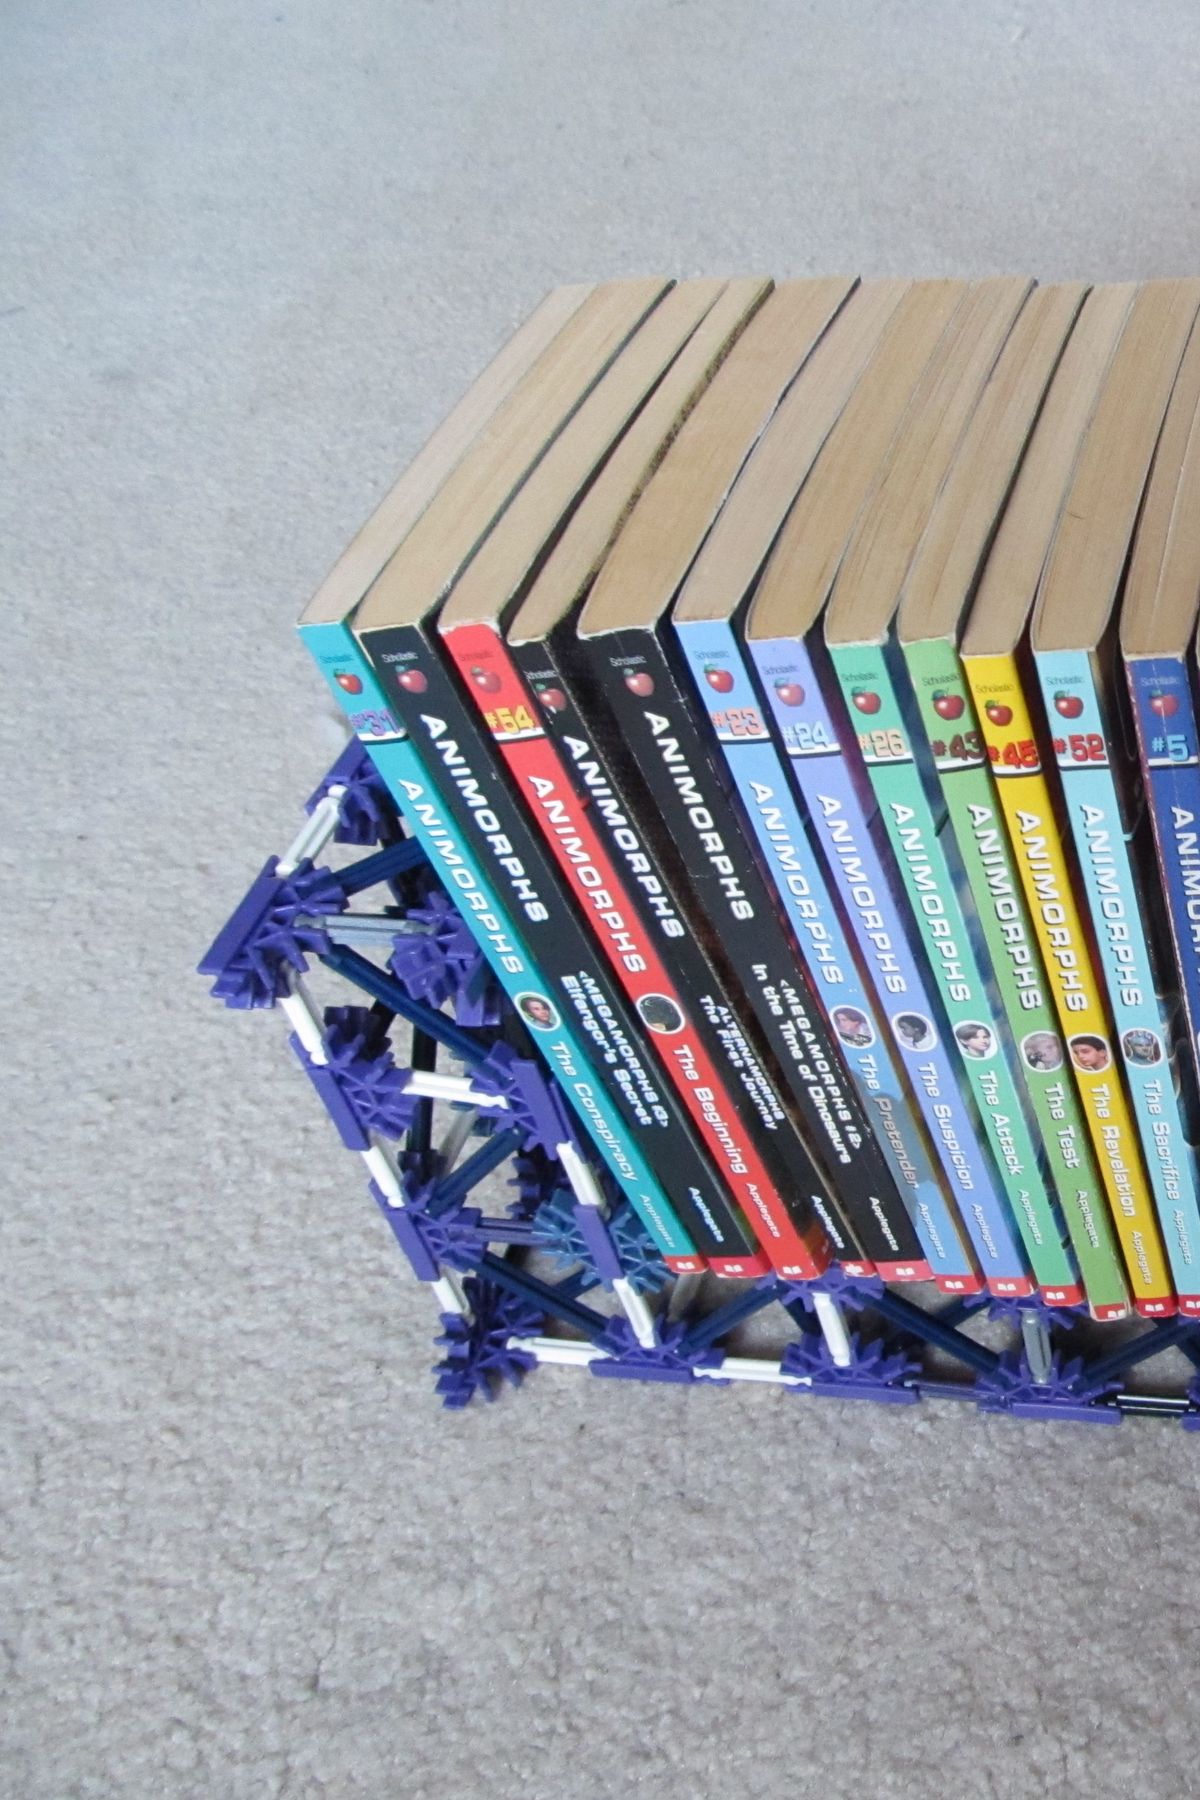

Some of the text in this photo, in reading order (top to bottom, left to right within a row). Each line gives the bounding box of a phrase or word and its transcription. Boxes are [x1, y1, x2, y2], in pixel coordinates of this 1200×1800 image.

[351, 709, 399, 736] #31
[485, 704, 535, 734] #54
[712, 708, 761, 736] #23
[841, 672, 879, 683] Scholastic
[923, 673, 961, 686] Scholastic
[976, 683, 1015, 694] Scholastic
[1046, 675, 1085, 686] Scholastic
[782, 722, 828, 750] #24
[859, 729, 905, 757] #26
[931, 731, 985, 761] #43
[1051, 733, 1105, 761] #52
[1152, 735, 1189, 761] #5
[420, 713, 549, 922] ANIMORPHS
[563, 735, 685, 938] ANIMORPHS
[644, 711, 754, 920] ANIMORPHS
[399, 778, 524, 974] ANIMORPHS
[528, 775, 647, 973] ANIMORPHS
[749, 781, 844, 984] ANIMORPHS
[816, 794, 907, 993] ANIMORPHS
[890, 802, 971, 1002] ANIMORPHS
[967, 803, 1042, 1010] ANIMORPHS
[1015, 809, 1089, 1012] ANIMORPHS
[1080, 804, 1143, 1007] ANIMORPHS
[561, 975, 653, 1126] Elfangor's Secret
[700, 994, 778, 1130] The First Journey
[716, 1005, 786, 1121] ALTERNAMORPHS
[751, 963, 851, 1164] In the Time of Dinosaurs
[551, 1040, 638, 1181] The Conspiracy
[673, 1044, 748, 1174] The Beginning
[857, 1054, 919, 1190] The Pretender
[917, 1062, 974, 1191] The Suspicion
[978, 1070, 1026, 1176] The Attack
[1045, 1082, 1080, 1169] The Test
[1090, 1083, 1137, 1217] The Revelation
[1143, 1079, 1180, 1201] The Sacrifice
[746, 1182, 781, 1239] Applegate
[869, 1196, 899, 1251] Applegate
[971, 1203, 998, 1259] Applegate
[1018, 1189, 1043, 1246] Applegate
[1077, 1190, 1099, 1248] Applegate
[1131, 1231, 1152, 1285] Applegate
[1173, 1209, 1192, 1265] Applegate
